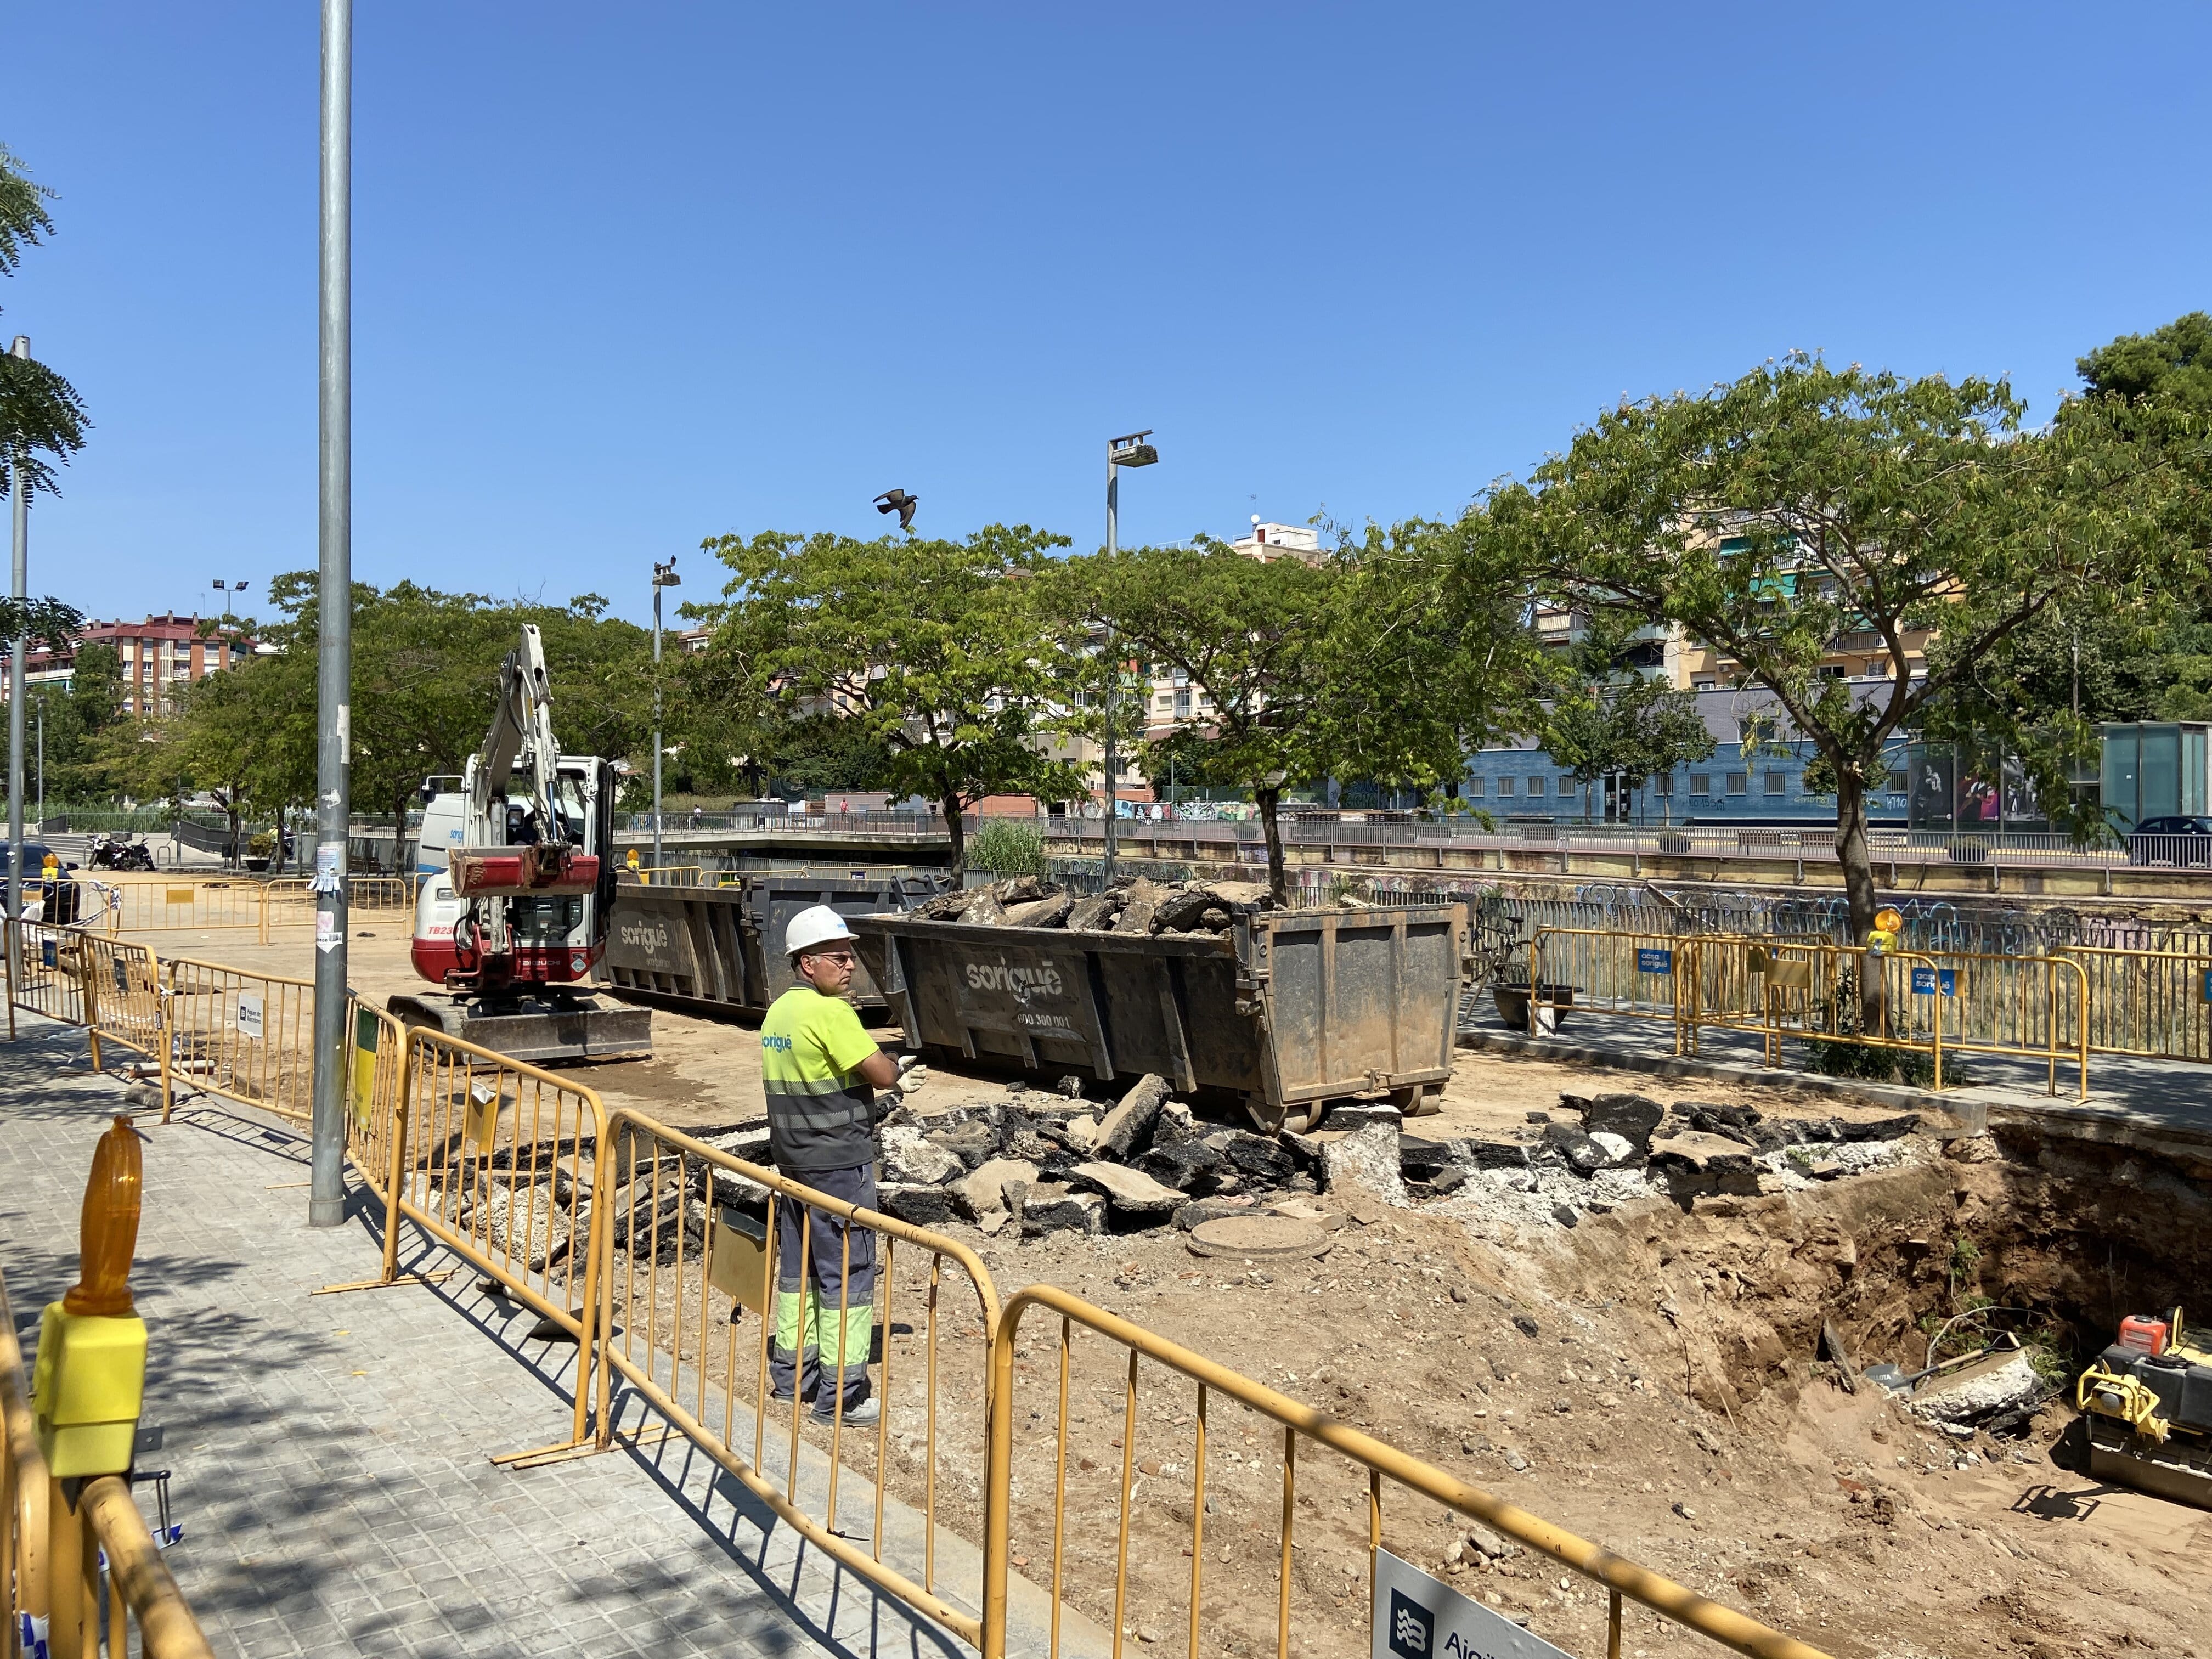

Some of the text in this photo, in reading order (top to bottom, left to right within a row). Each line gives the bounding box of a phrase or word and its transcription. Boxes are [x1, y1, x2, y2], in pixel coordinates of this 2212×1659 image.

[450, 826, 464, 844] sorig
[1017, 1014, 1070, 1028] 600 300 001
